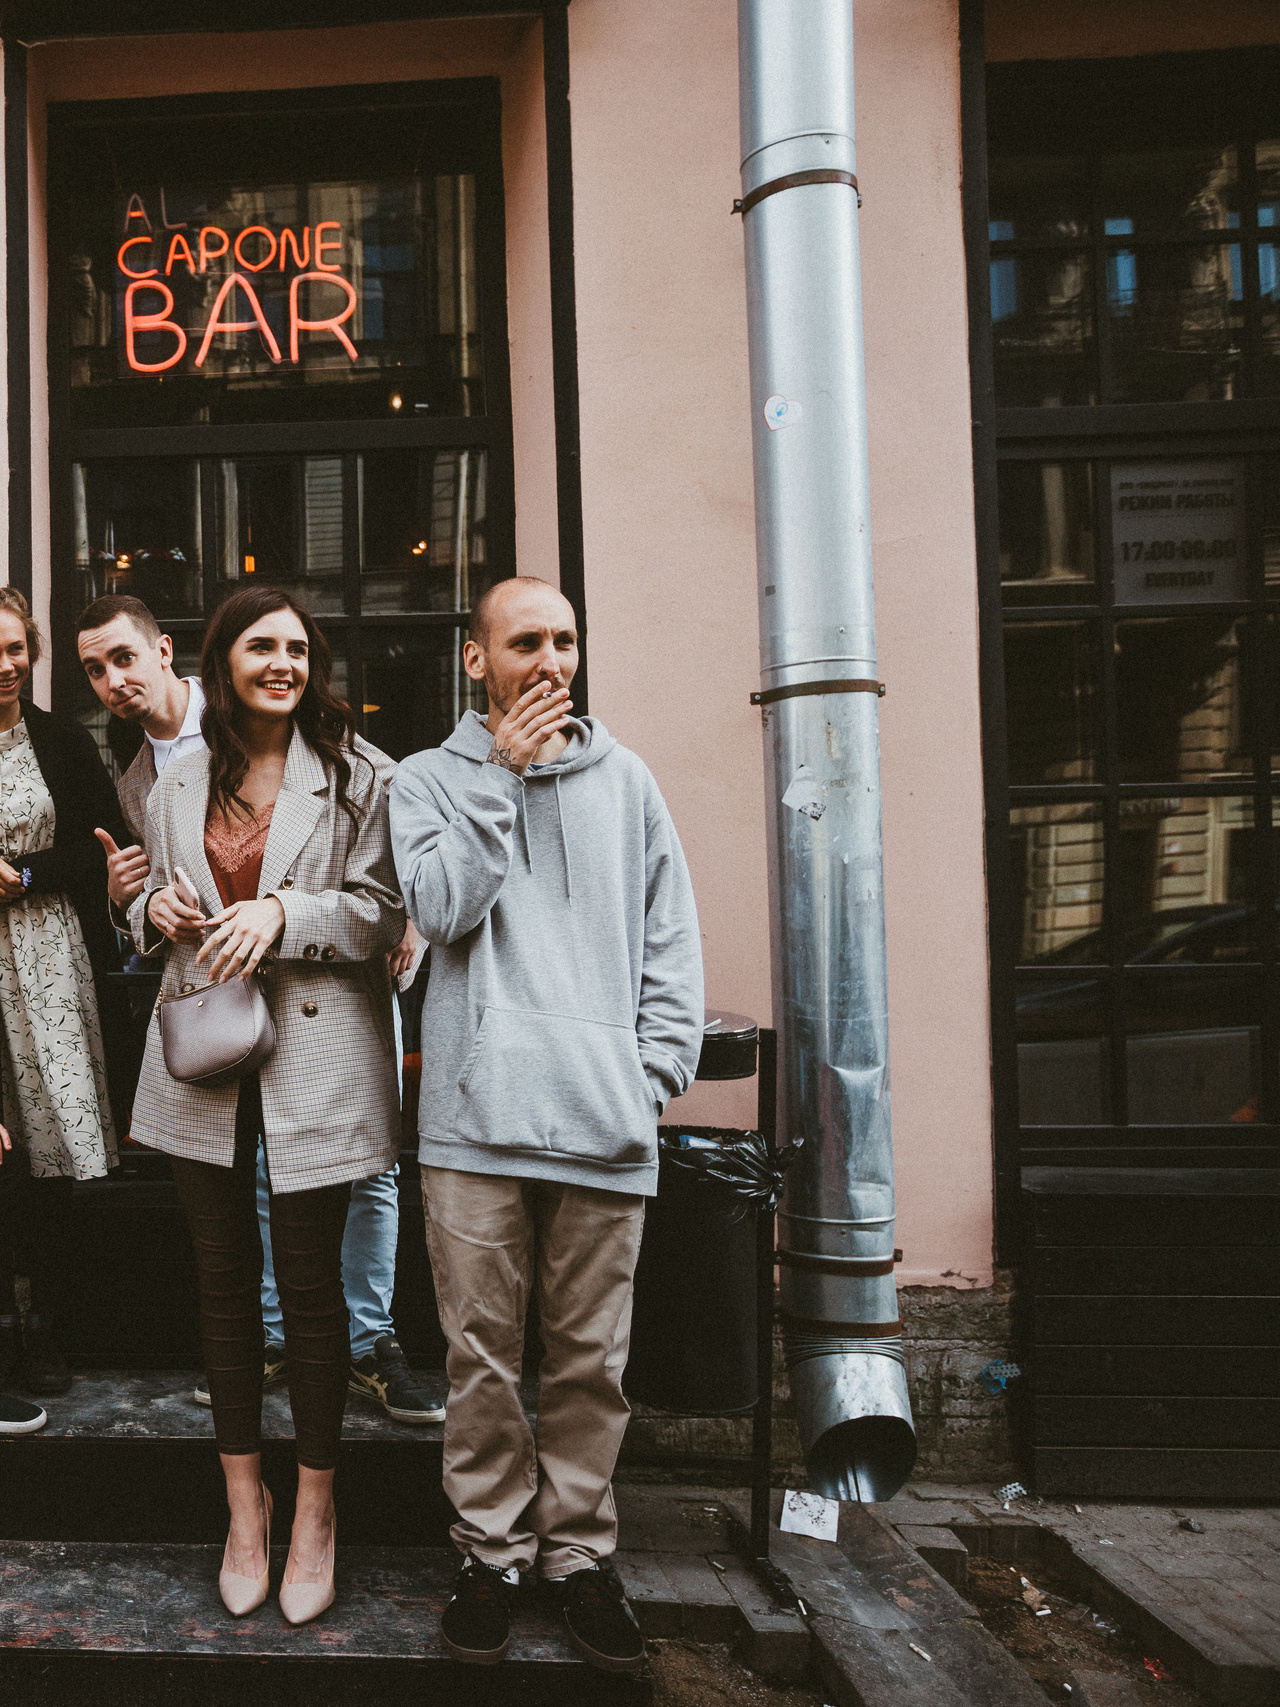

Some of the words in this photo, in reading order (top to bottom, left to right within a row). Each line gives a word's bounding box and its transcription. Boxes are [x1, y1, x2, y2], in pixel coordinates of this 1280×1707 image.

[124, 186, 188, 233] AL
[117, 221, 342, 279] CAPONE
[125, 271, 358, 373] BAR
